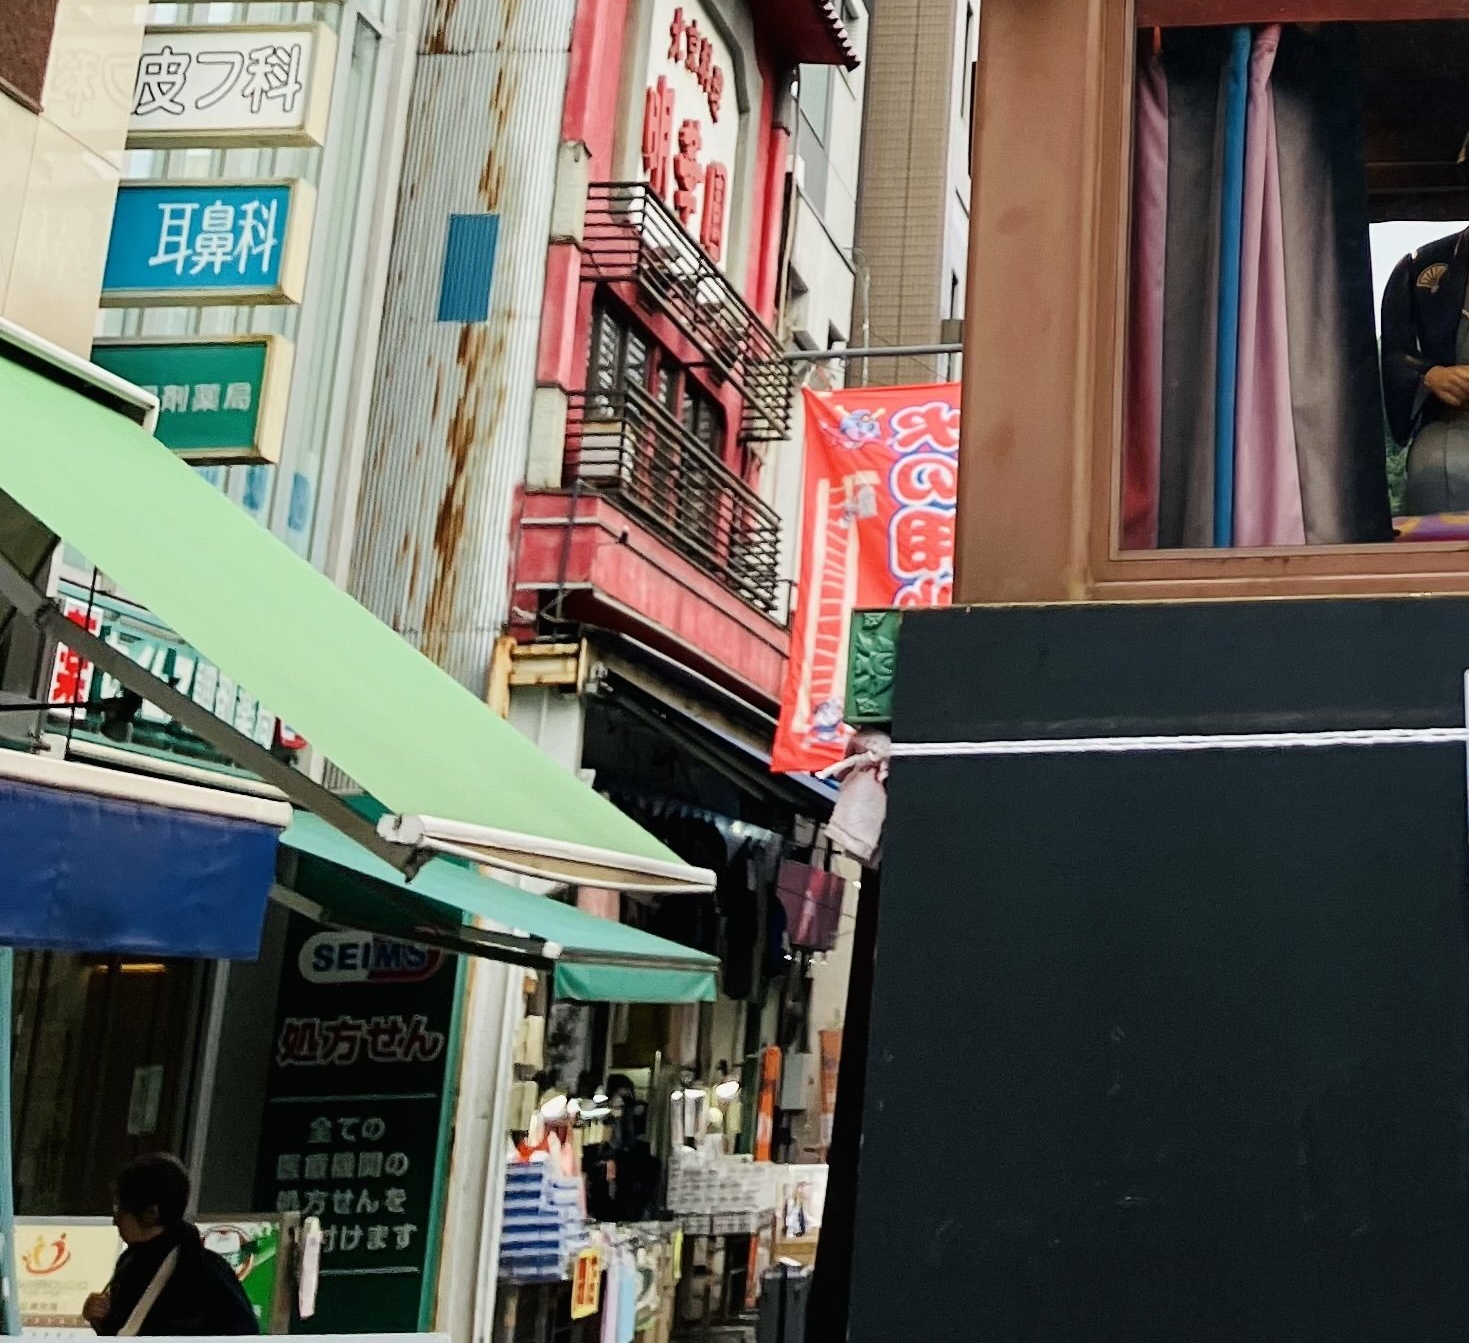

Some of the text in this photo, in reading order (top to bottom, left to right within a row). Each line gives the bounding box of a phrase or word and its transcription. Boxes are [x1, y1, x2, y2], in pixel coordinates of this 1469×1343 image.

[133, 43, 302, 115] 皮フ科
[148, 198, 279, 276] 耳鼻科
[142, 381, 253, 414] 剤薬局
[311, 939, 430, 973] SEIMS
[277, 1014, 444, 1067] 処方せん
[309, 1115, 387, 1145] 全ての
